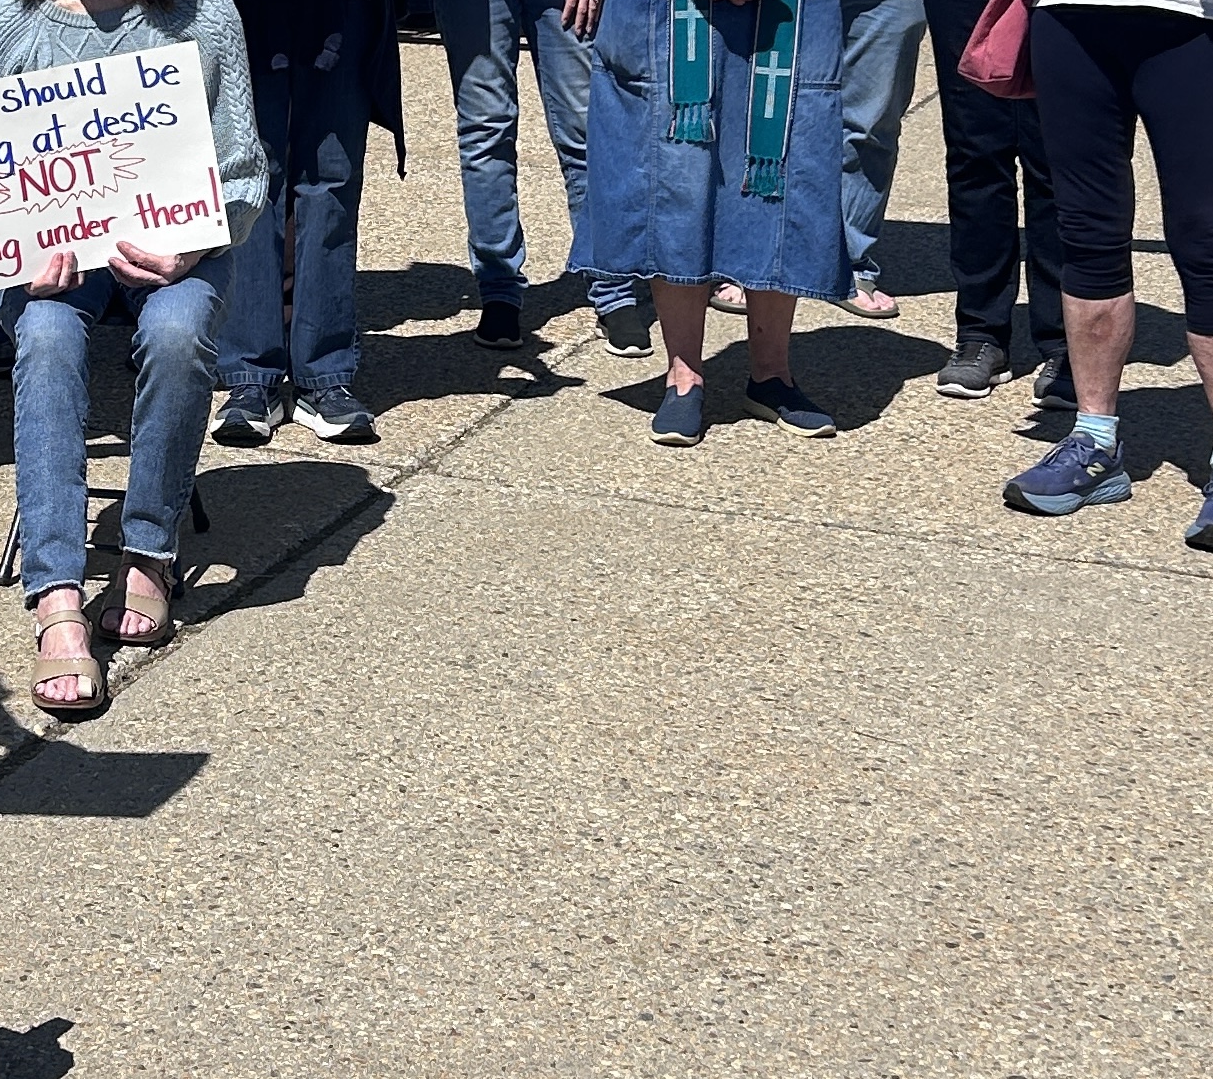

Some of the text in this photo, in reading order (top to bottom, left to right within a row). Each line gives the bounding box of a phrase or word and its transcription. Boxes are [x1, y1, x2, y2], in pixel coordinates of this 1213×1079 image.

[0, 62, 107, 114] should
[136, 55, 181, 90] be
[31, 113, 67, 154] at
[81, 102, 179, 141] desks
[18, 148, 102, 203] NOT
[36, 206, 118, 250] under
[132, 166, 225, 230] them!
